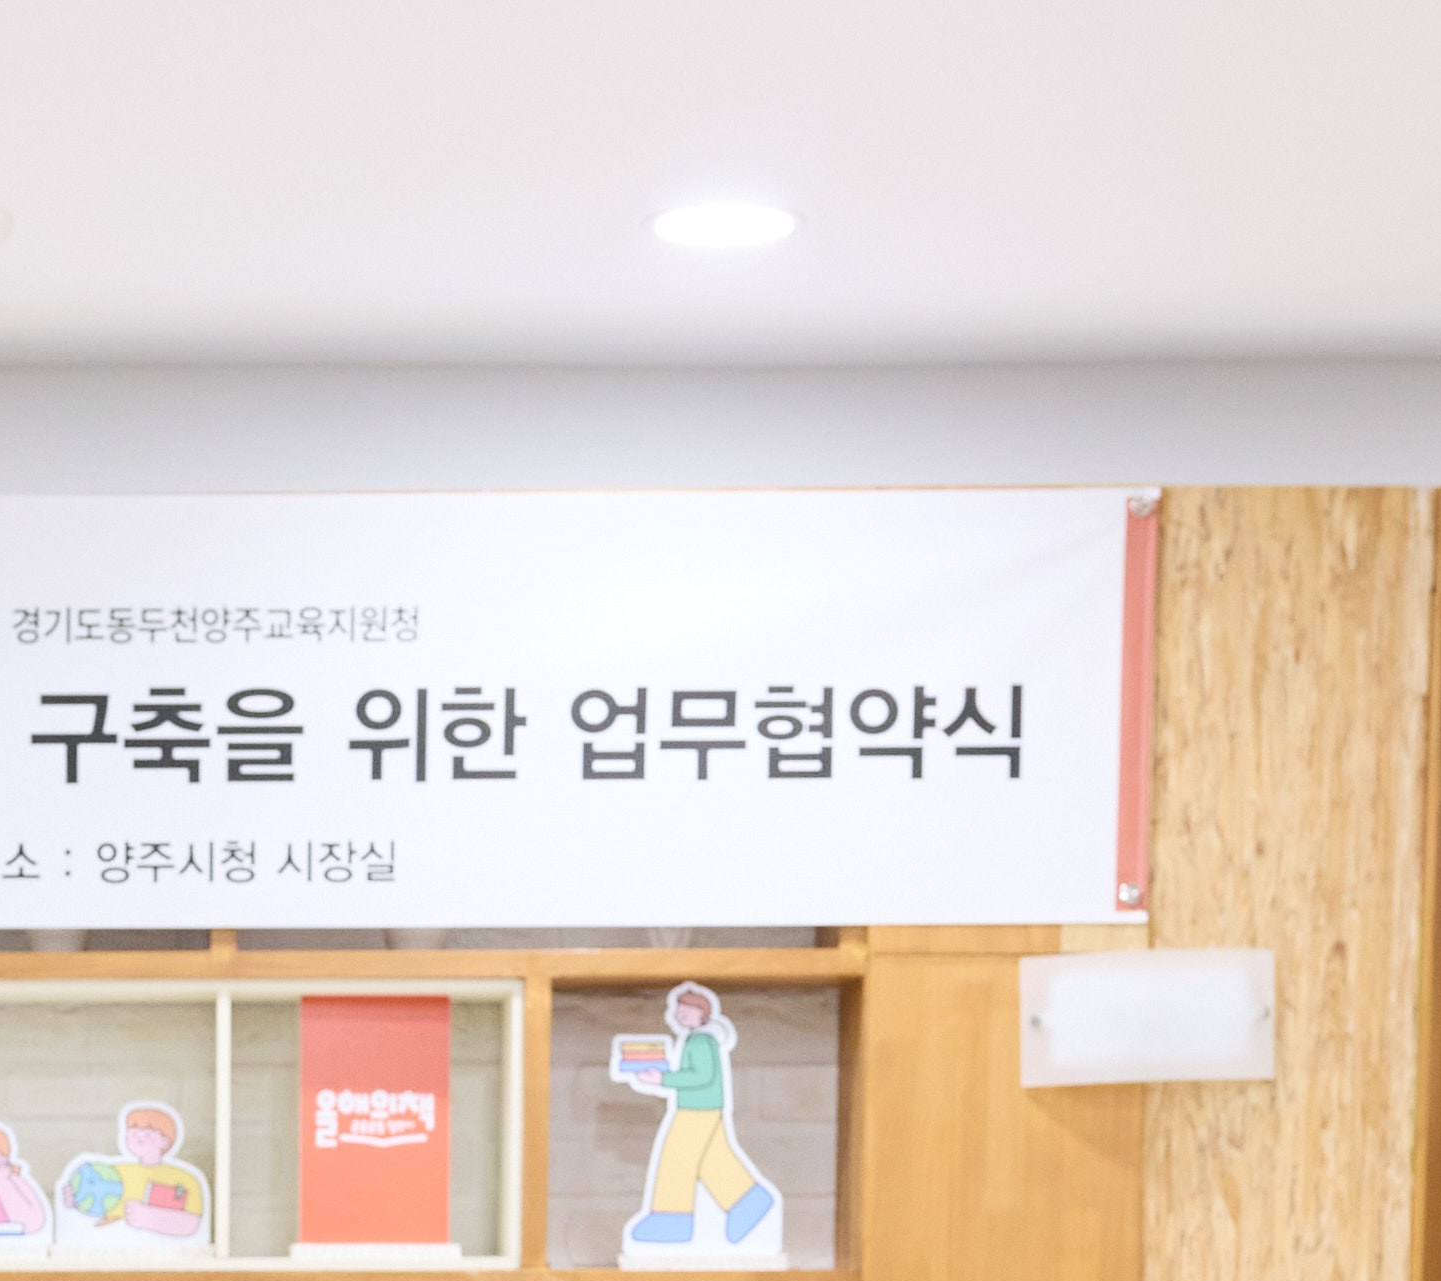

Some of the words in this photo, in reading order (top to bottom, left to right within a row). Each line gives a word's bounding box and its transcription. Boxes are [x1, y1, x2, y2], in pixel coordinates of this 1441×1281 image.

[14, 608, 417, 644] 경기도동두천양주교육지원청
[31, 688, 303, 784] 구축을
[349, 687, 526, 782] 위한
[571, 685, 1022, 780] 업무협약식
[97, 842, 255, 883] 양주시청
[278, 842, 394, 882] 시장실
